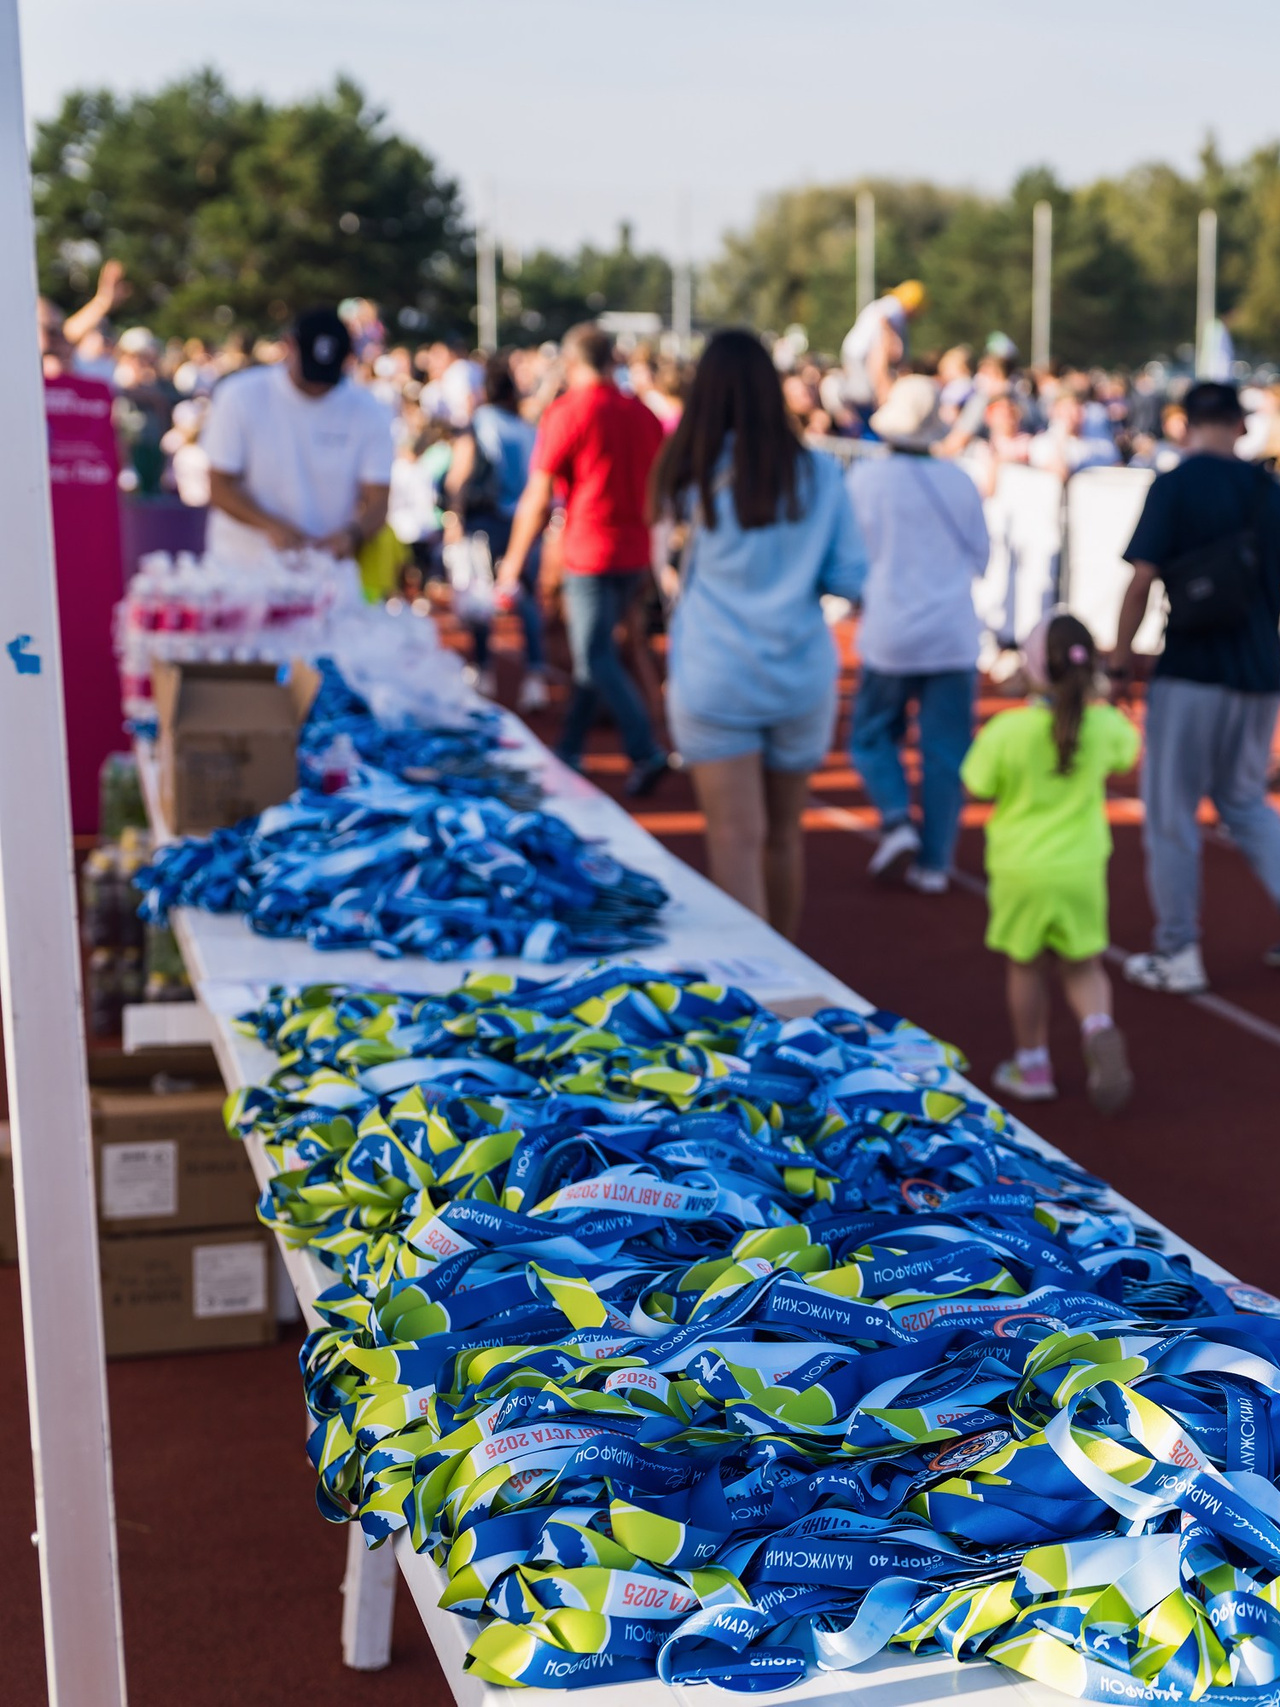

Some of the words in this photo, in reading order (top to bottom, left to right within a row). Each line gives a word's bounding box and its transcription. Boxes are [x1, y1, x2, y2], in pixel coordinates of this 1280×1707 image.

[603, 1183, 661, 1206] АВГУСТА
[664, 1193, 682, 1209] 29
[425, 1229, 459, 1256] 2025
[1042, 1249, 1056, 1262] 40
[874, 1259, 933, 1282] МАРАФОН
[772, 1295, 851, 1325] КАЛУЖСКИЙ
[866, 1315, 883, 1325] 40
[901, 1308, 935, 1331] 2025
[886, 1320, 918, 1343] СПОРТ
[617, 1373, 656, 1389] 2025
[484, 1433, 529, 1459] 2025
[575, 1446, 634, 1468] МАРАФОН
[1169, 1439, 1199, 1468] 2025
[808, 1477, 824, 1492] 40
[829, 1475, 865, 1503] СПОРТ
[1155, 1473, 1222, 1515] МАРАФОН
[765, 1551, 853, 1570] КАЛУЖСКИЙ
[869, 1555, 888, 1566] 40
[892, 1555, 942, 1566] СПОРТ
[622, 1583, 668, 1609] 2025
[543, 1653, 613, 1677] МАРАФОН
[749, 1658, 805, 1667] СПОРТ
